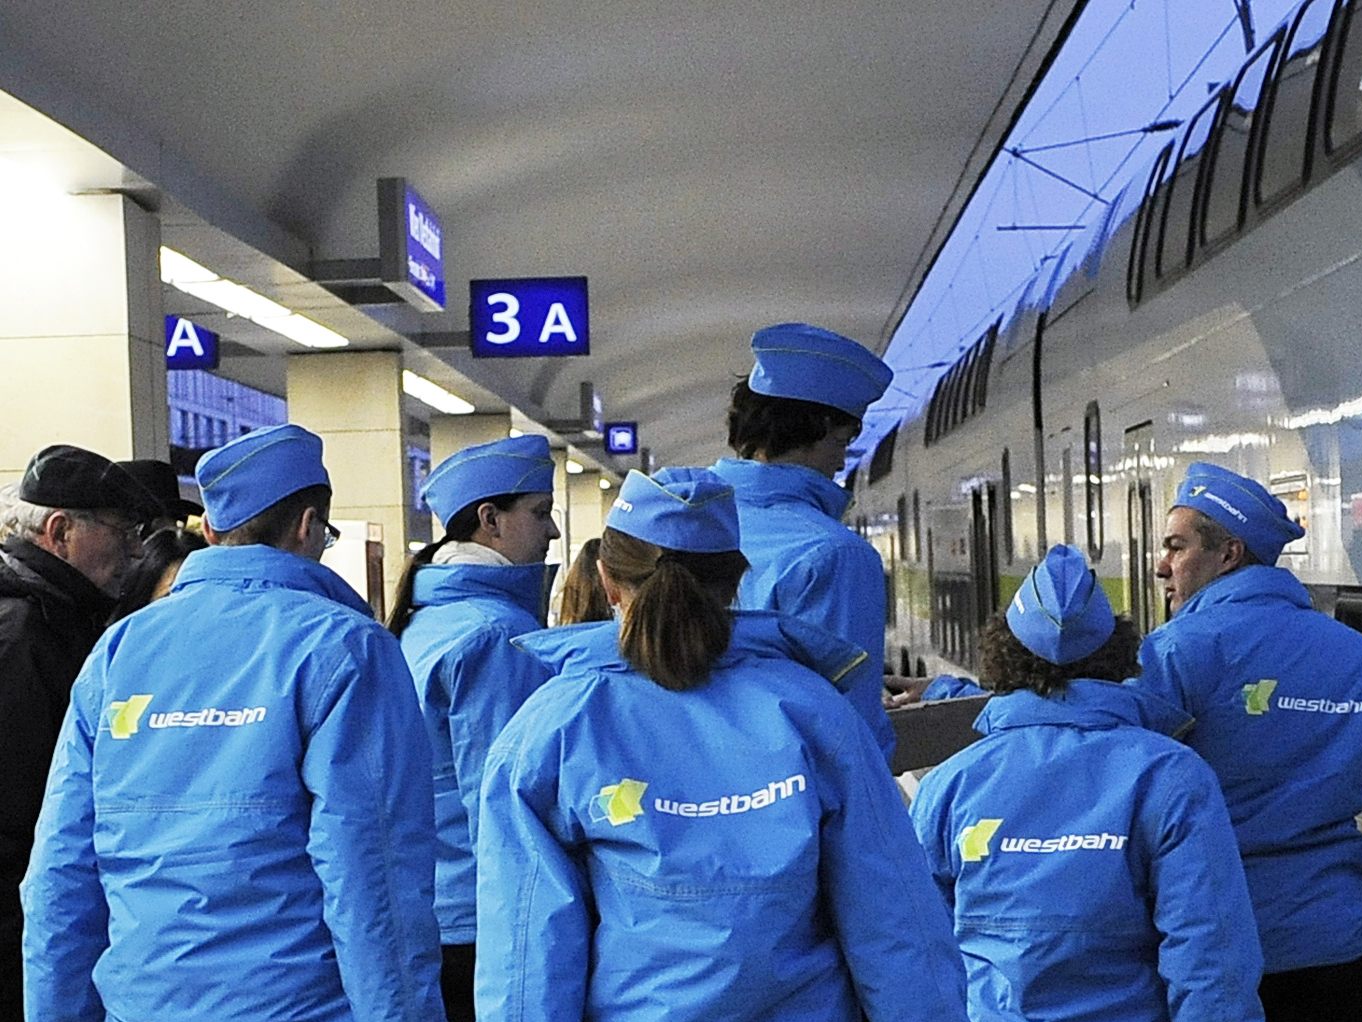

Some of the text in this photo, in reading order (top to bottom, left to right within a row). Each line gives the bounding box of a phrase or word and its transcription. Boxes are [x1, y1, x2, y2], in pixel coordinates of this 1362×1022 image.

[166, 317, 204, 357] A
[486, 292, 577, 344] 3 A
[654, 774, 806, 817] westbahn
